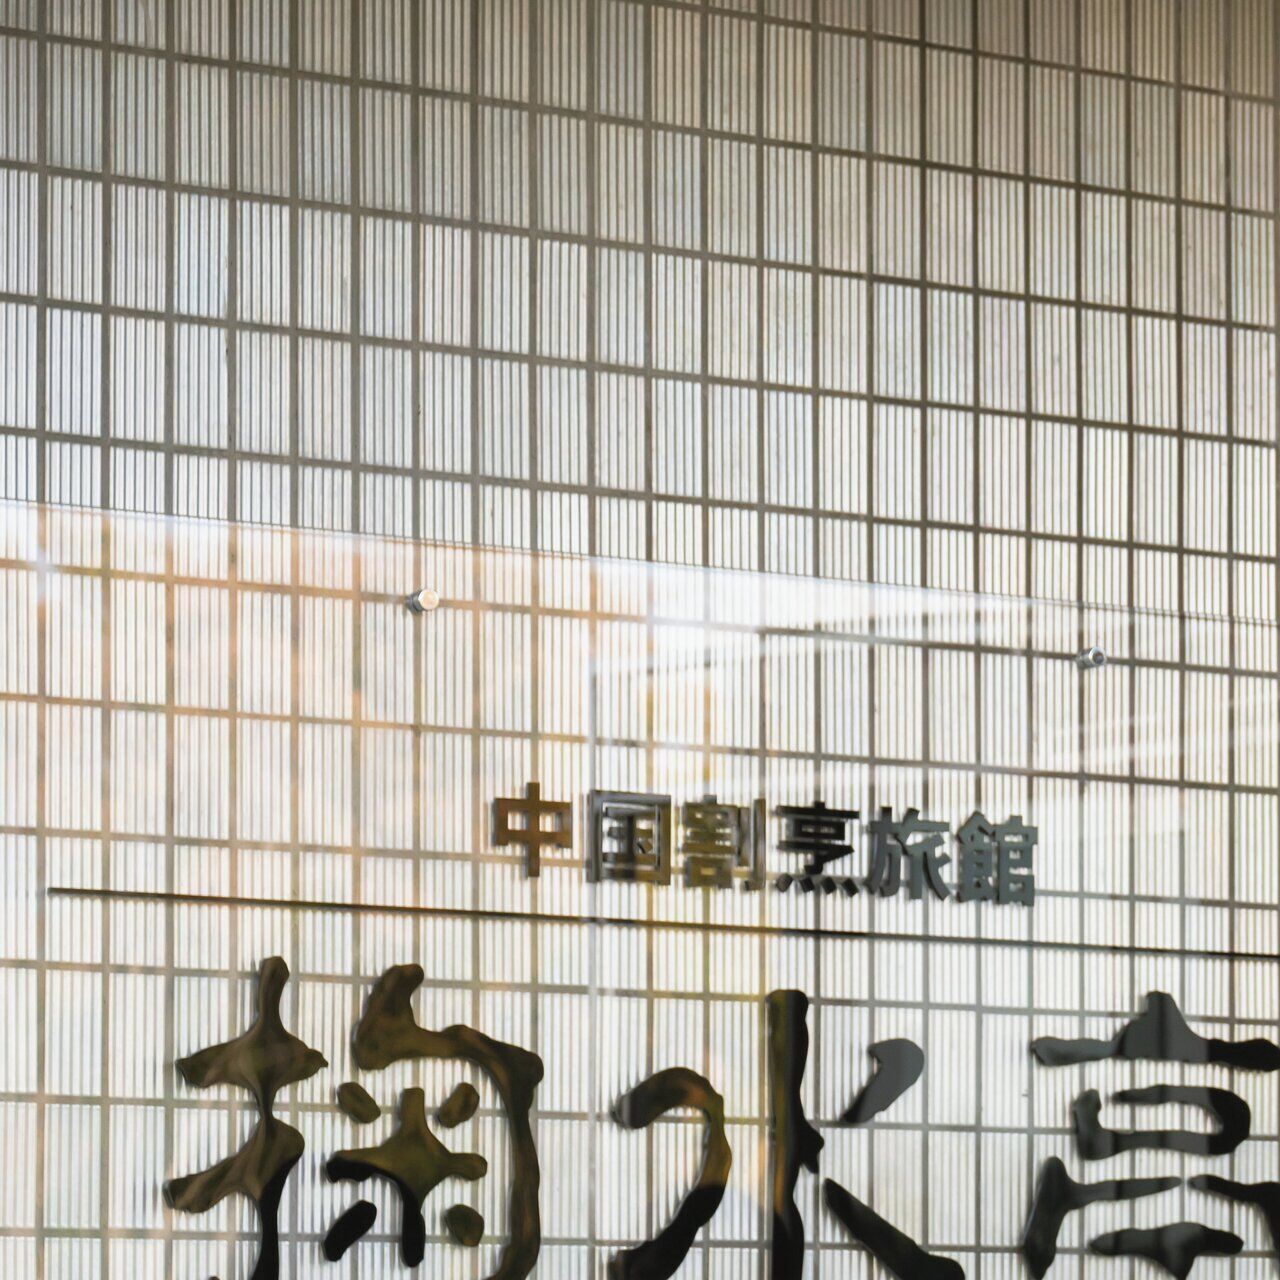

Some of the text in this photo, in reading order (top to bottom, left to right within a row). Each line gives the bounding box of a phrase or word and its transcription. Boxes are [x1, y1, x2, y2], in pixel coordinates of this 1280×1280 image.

[492, 782, 1038, 907] 中国割烹旅館
